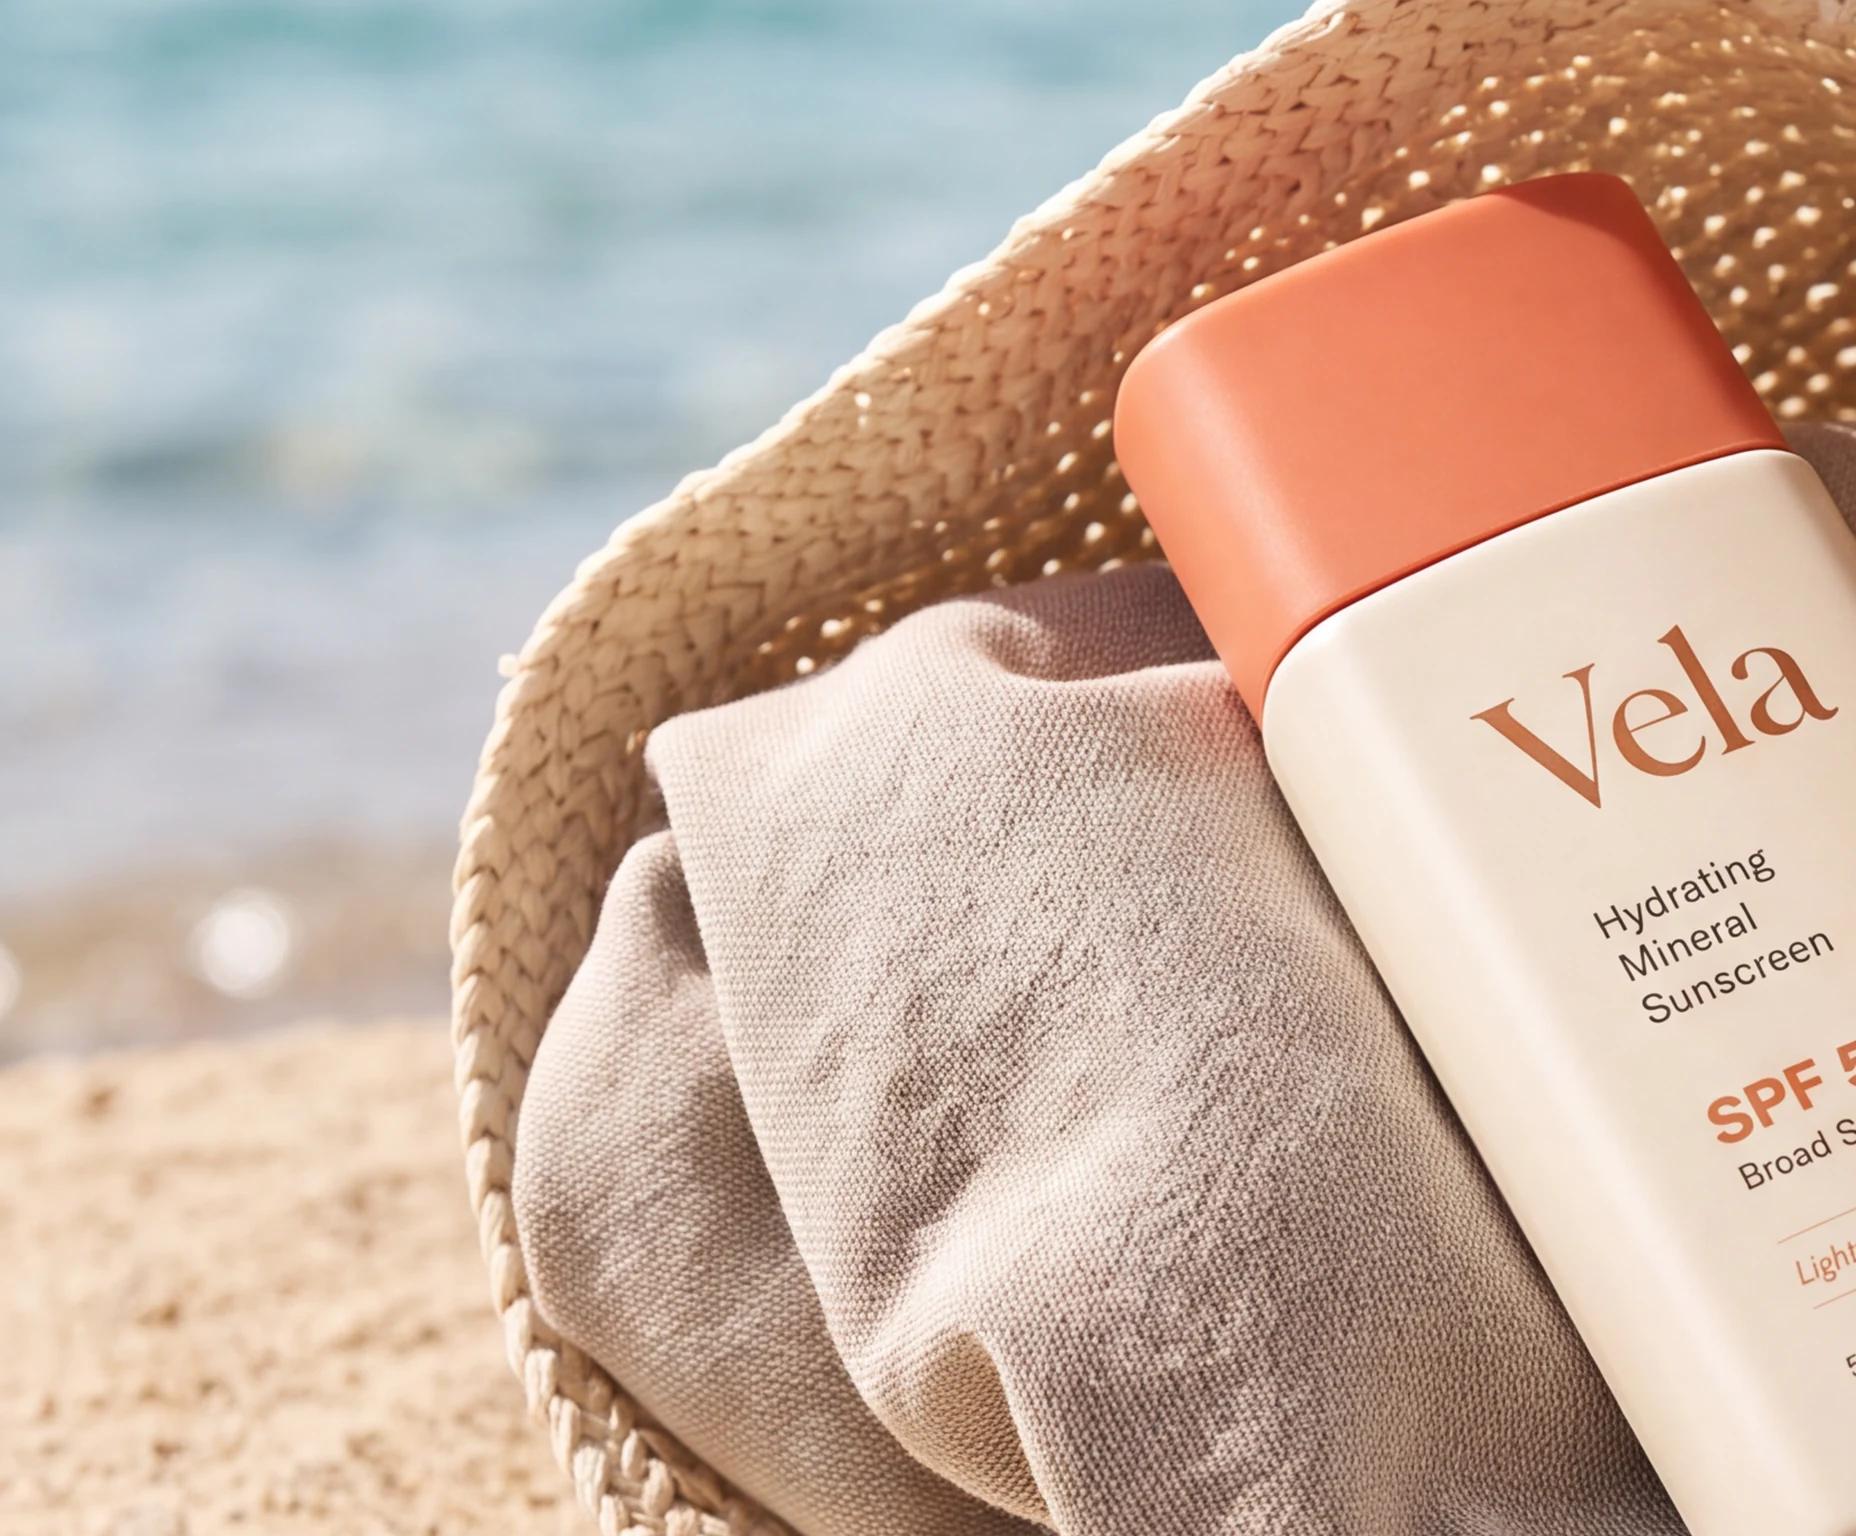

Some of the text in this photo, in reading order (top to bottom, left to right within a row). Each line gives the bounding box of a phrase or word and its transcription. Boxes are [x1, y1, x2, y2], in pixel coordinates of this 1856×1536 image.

[1469, 624, 1840, 810] Vela
[1592, 848, 1776, 940] Hydrating
[1617, 901, 1758, 982] Mineral
[1641, 932, 1835, 1024] Sunscreen
[1707, 1057, 1823, 1145] SPF
[1737, 1129, 1833, 1191] Broad
